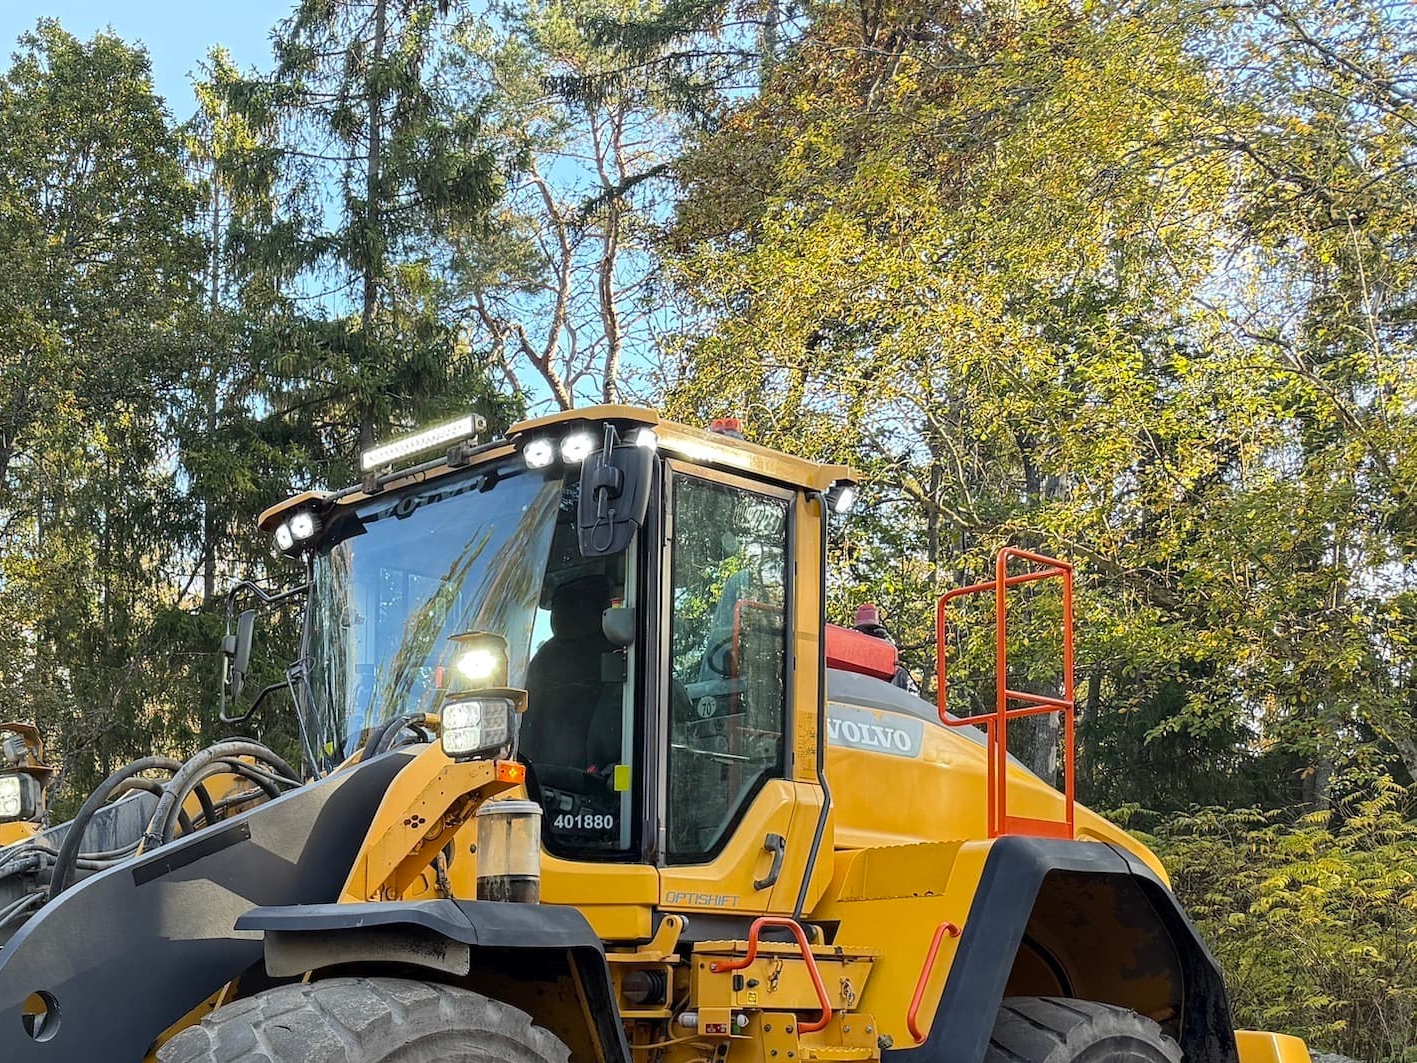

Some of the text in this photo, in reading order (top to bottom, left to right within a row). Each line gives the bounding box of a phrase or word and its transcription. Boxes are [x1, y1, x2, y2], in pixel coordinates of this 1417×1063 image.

[827, 718, 912, 752] VOLVO
[553, 814, 614, 829] 401880
[665, 891, 740, 907] OPTISHIFT
